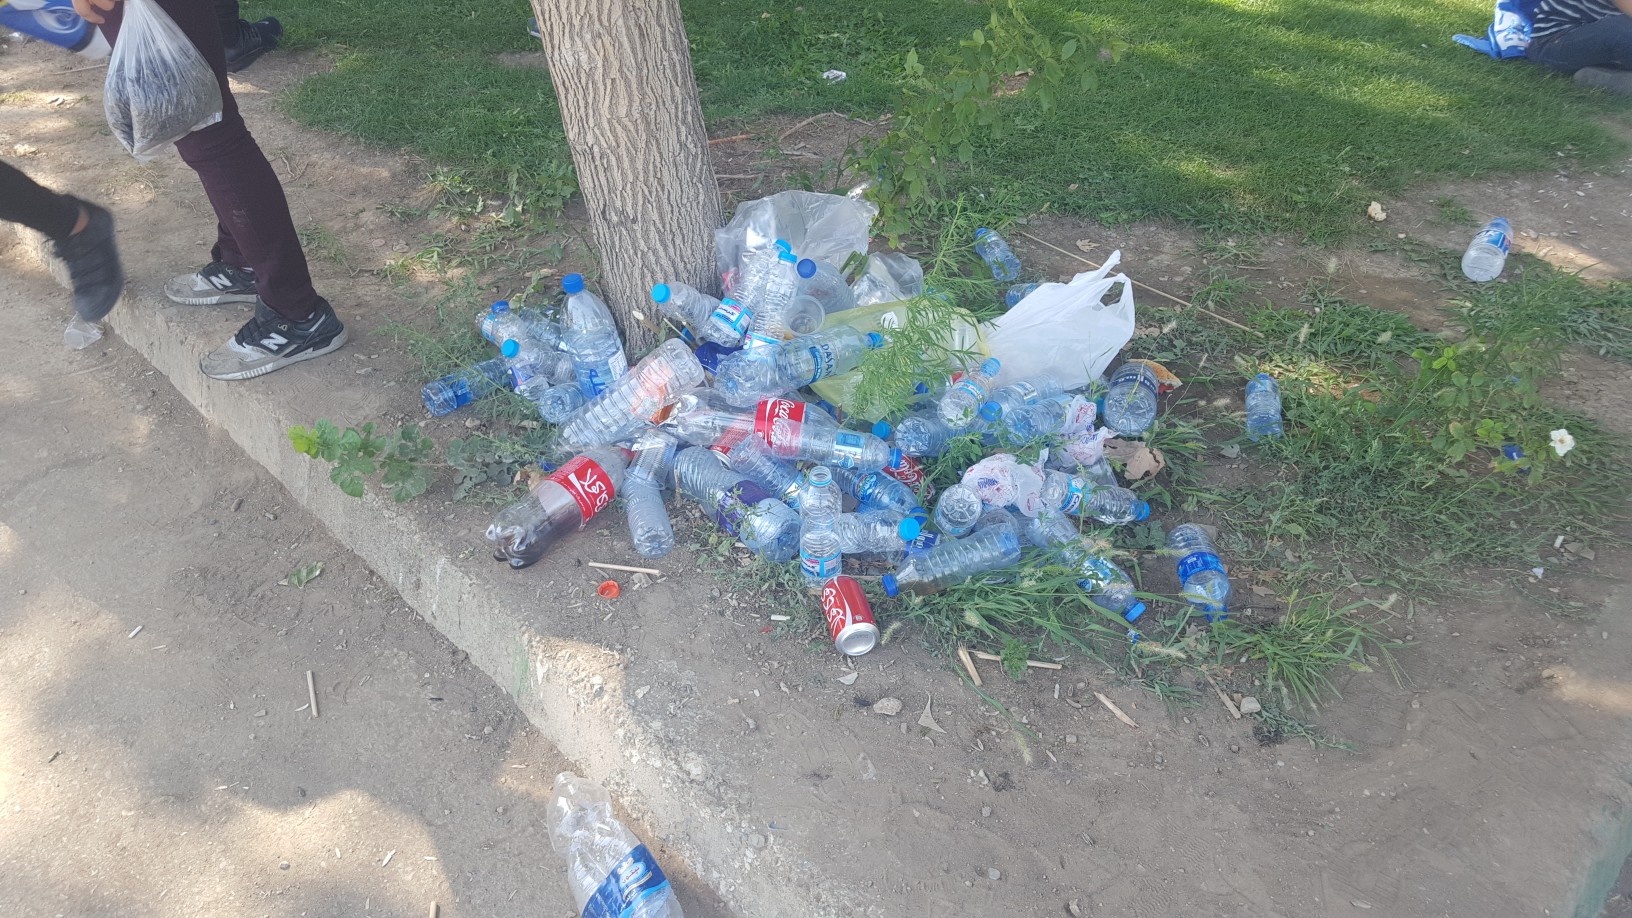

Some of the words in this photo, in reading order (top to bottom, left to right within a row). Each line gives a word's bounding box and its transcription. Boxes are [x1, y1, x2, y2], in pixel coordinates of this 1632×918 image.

[209, 273, 233, 290] N
[260, 333, 289, 351] N
[821, 343, 834, 378] DASAN
